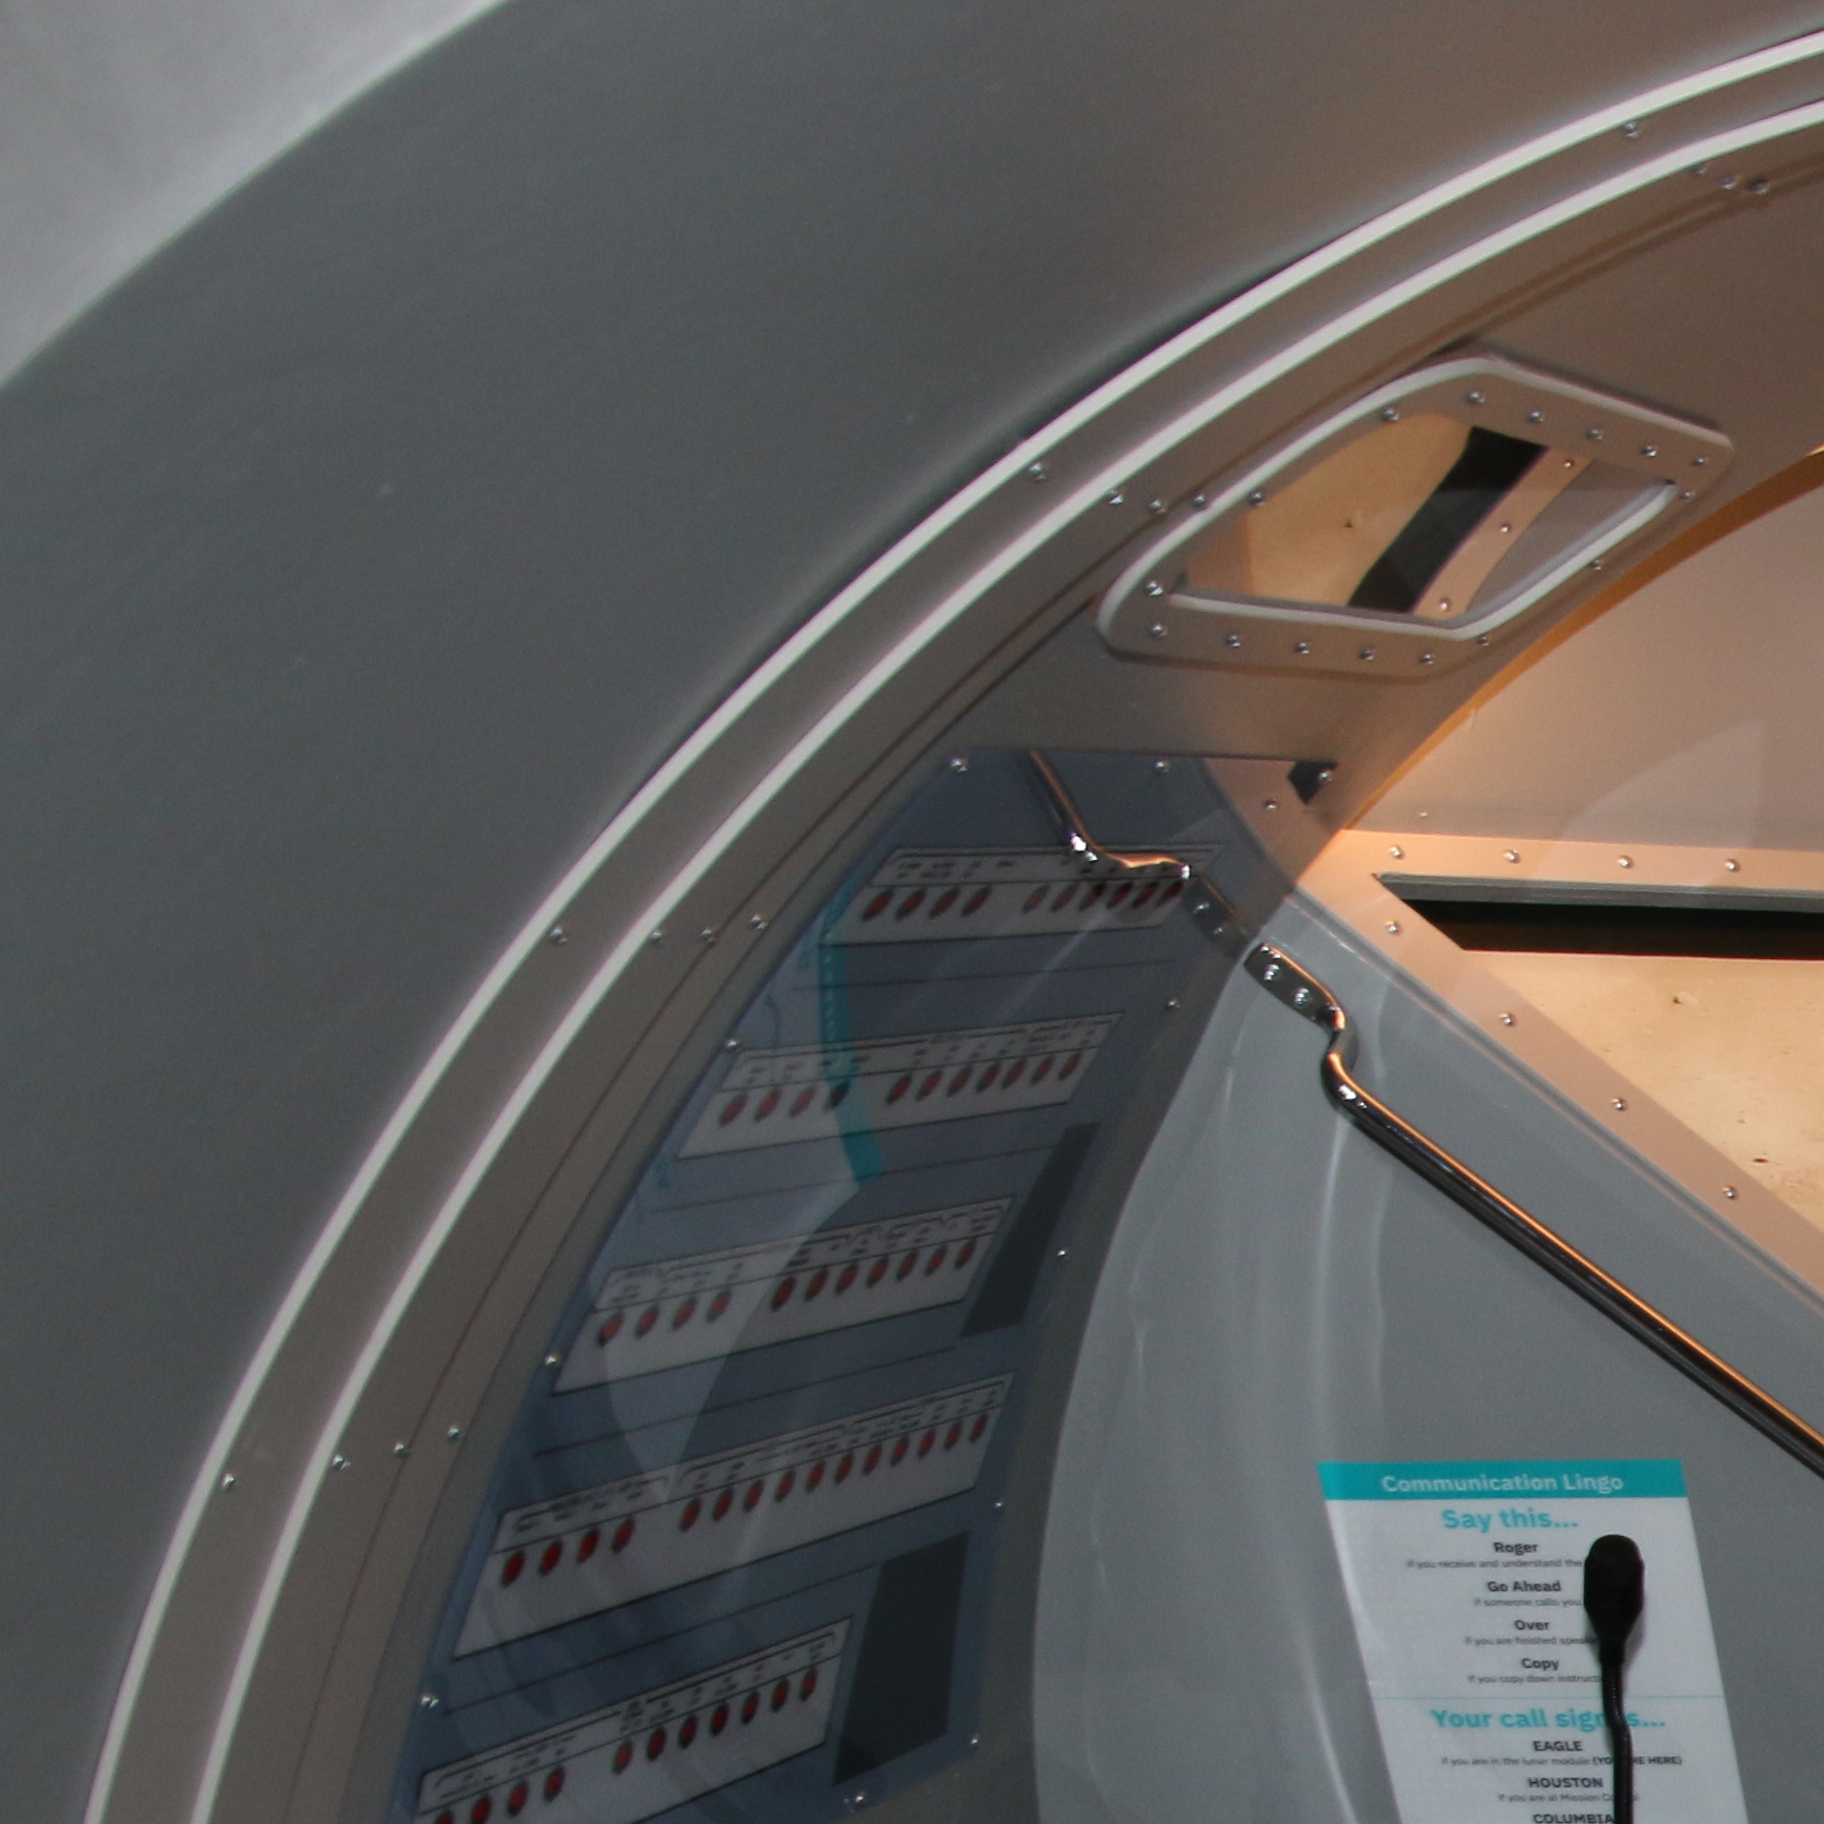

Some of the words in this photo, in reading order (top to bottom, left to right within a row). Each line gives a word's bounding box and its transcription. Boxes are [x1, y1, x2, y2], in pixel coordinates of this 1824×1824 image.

[1382, 1475, 1558, 1492] Communication
[1563, 1473, 1623, 1494] Lingo
[1442, 1508, 1492, 1533] Say
[1500, 1508, 1578, 1529] this...
[1494, 1542, 1539, 1555] Roger
[1416, 1560, 1436, 1569] you
[1479, 1559, 1499, 1567] and
[1502, 1559, 1562, 1567] understand
[1565, 1558, 1582, 1566] the
[1487, 1581, 1508, 1592] Go
[1513, 1581, 1561, 1592] Ahead
[1515, 1620, 1550, 1631] Over
[1522, 1658, 1559, 1671] Copy
[1478, 1676, 1497, 1684] you
[1500, 1676, 1523, 1684] copy
[1526, 1675, 1554, 1683] down
[1430, 1709, 1492, 1728] Your
[1500, 1707, 1549, 1727] call
[1533, 1741, 1582, 1751] EAGLE
[1648, 1756, 1682, 1765] HERE)
[1528, 1777, 1603, 1788] HOUSTON
[1533, 1814, 1614, 1824] COLUMBIA
